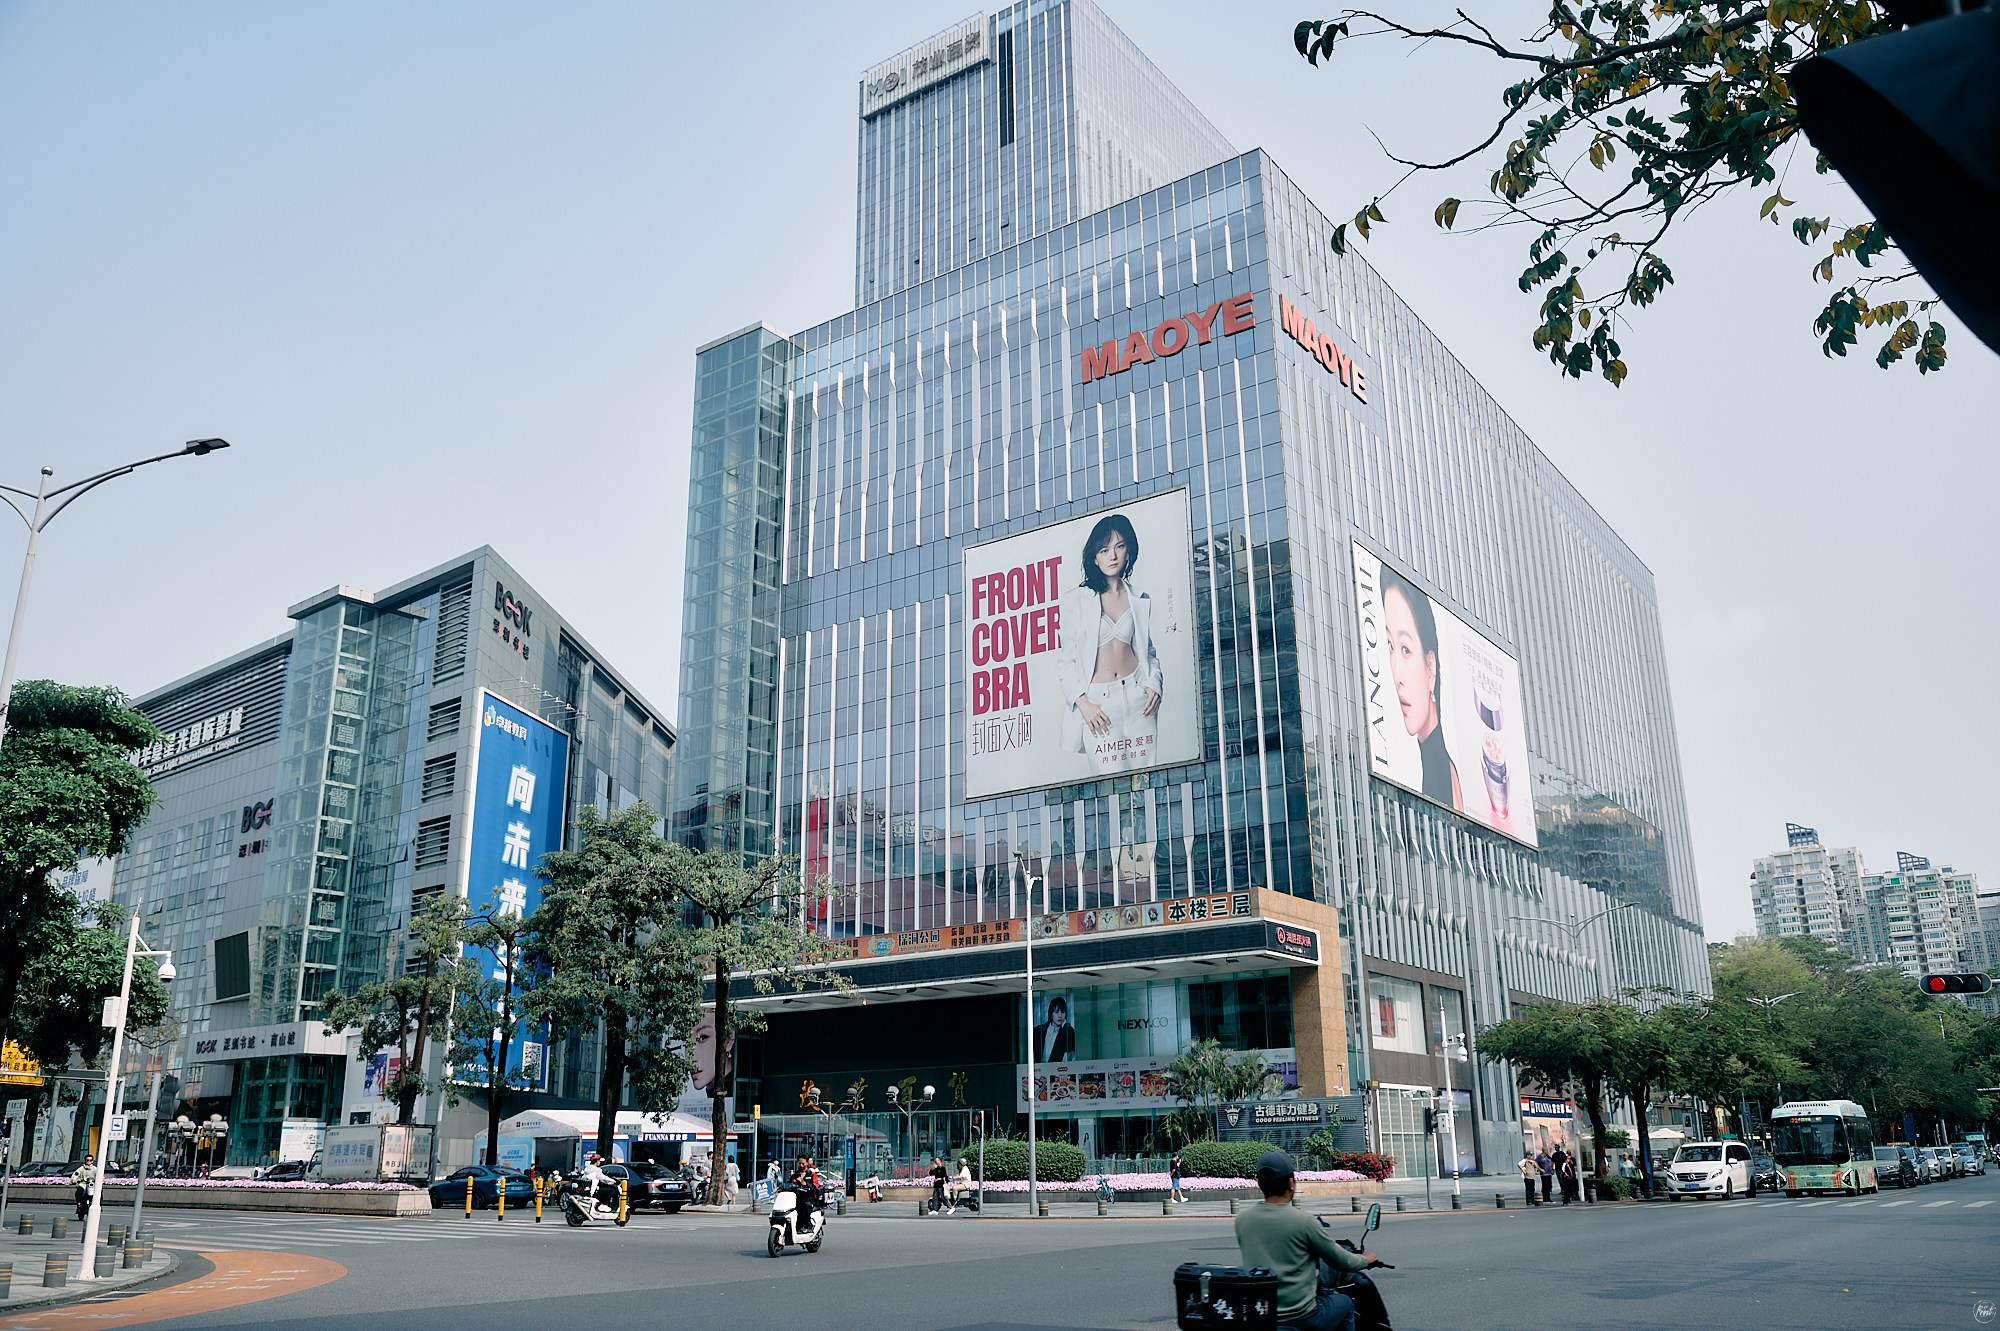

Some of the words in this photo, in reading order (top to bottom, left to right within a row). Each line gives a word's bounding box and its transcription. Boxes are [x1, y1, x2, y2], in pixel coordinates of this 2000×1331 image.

[912, 29, 981, 79] 茂业百货
[1081, 291, 1256, 384] MAOYE
[1279, 293, 1367, 405] MAOYE
[972, 556, 1062, 620] FRONT
[972, 605, 1062, 667] COVER
[972, 661, 1031, 716] BRA
[496, 715, 527, 740] 卓越教育
[972, 712, 1032, 756] 封面文胸
[1135, 734, 1154, 747] 爱慕
[1168, 892, 1251, 922] 本楼三层
[951, 926, 965, 936] 乐园
[973, 924, 987, 934] 运动
[981, 932, 1010, 944] 亲子互动
[1255, 1103, 1318, 1117] 古德菲力健身
[1327, 1104, 1340, 1114] 9F
[644, 1133, 669, 1141] FUANNA
